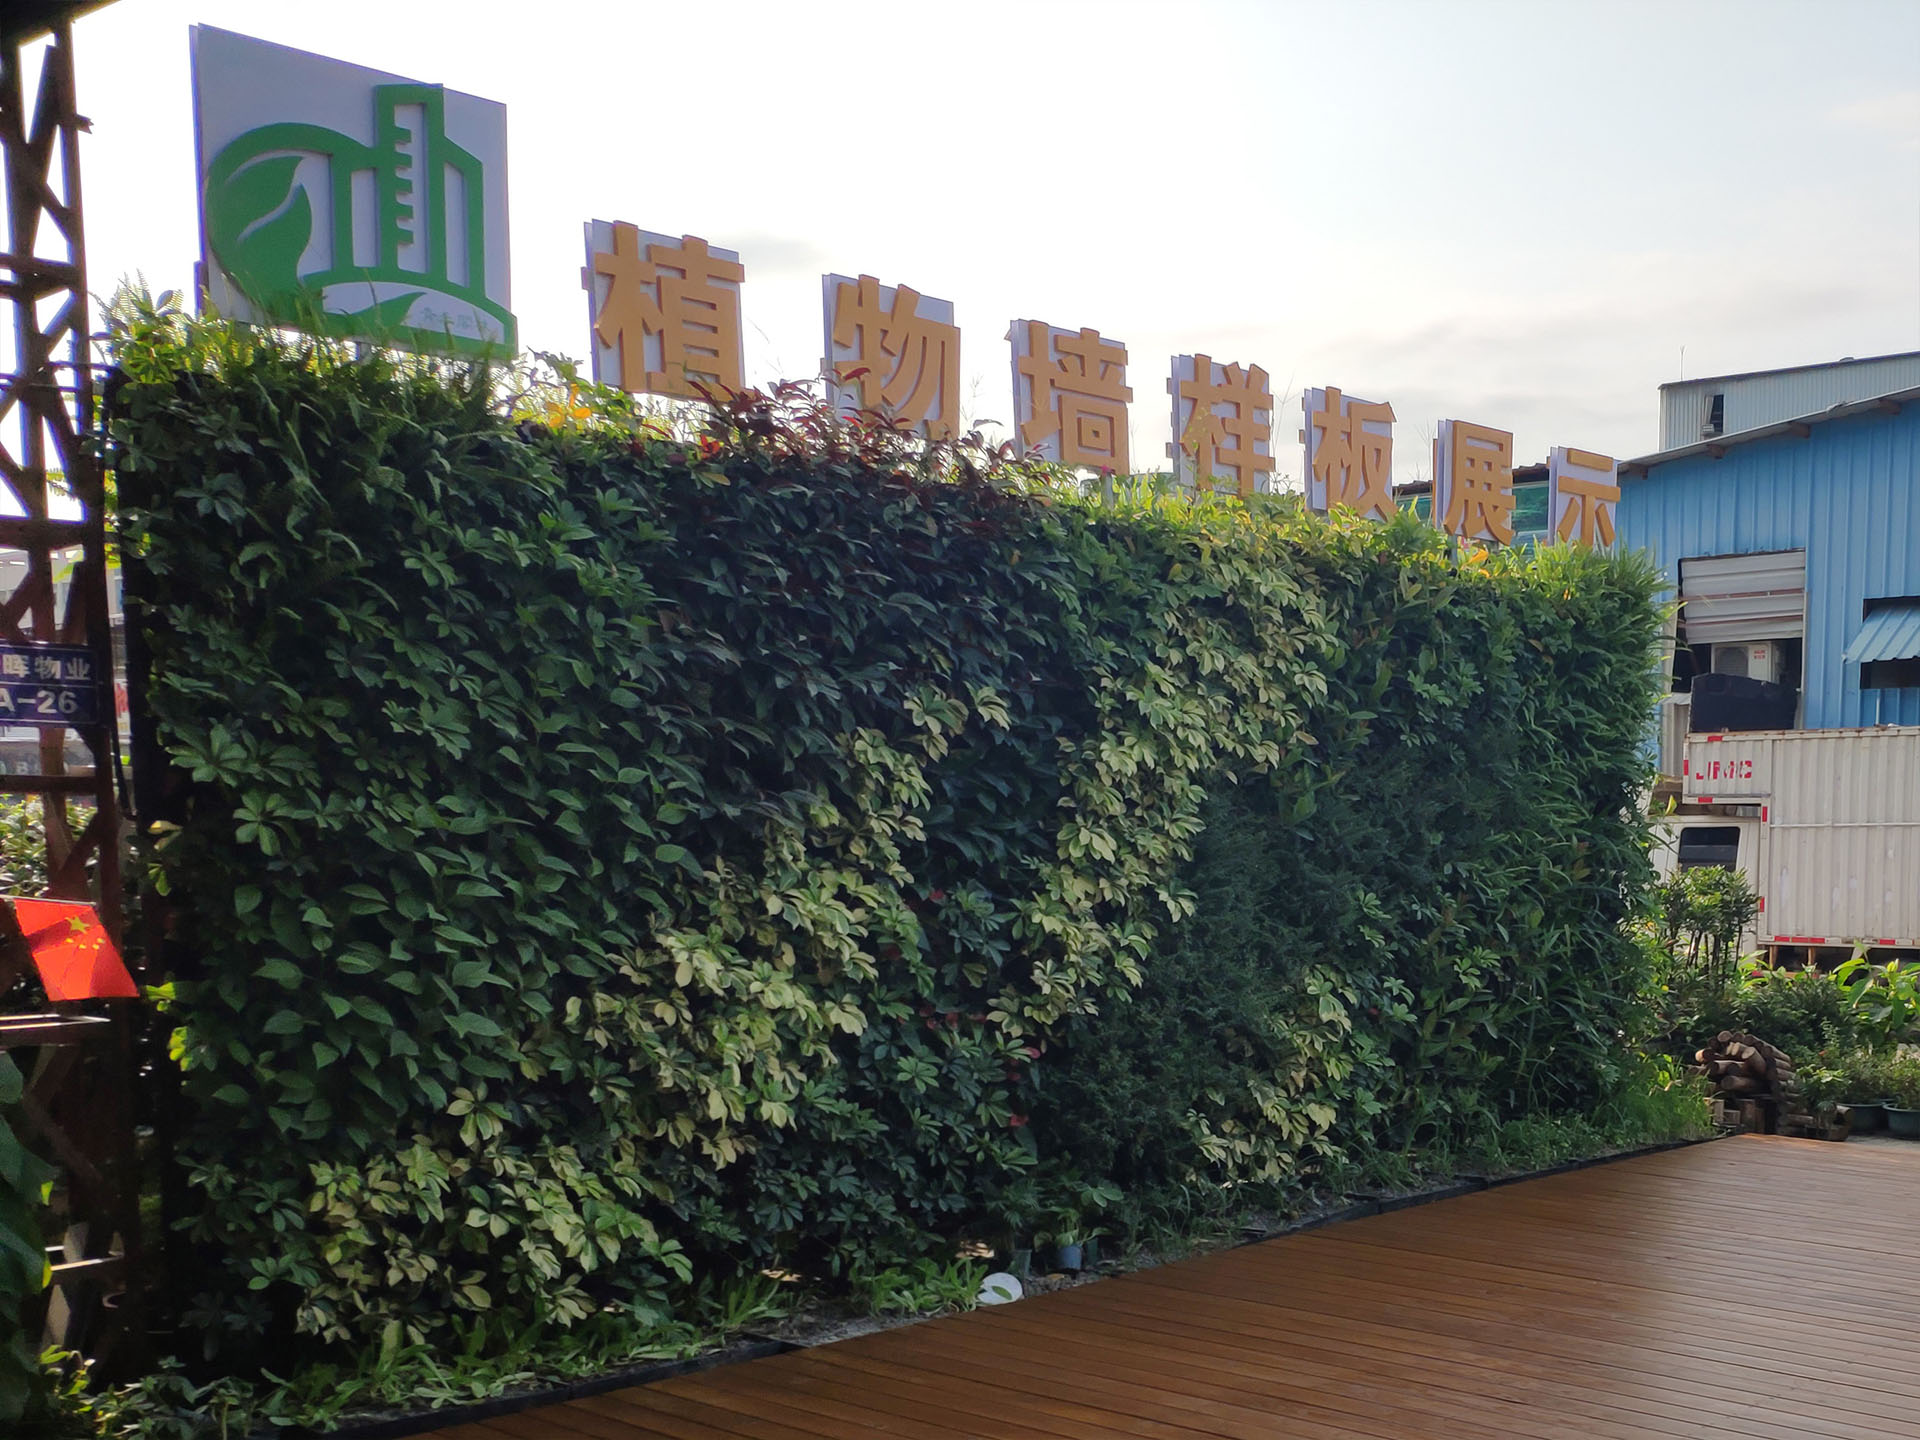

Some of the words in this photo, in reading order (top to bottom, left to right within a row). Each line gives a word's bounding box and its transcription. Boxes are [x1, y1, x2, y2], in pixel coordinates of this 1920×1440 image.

[594, 220, 1621, 547] 植物墙样板展示
[0, 687, 79, 714] A-26
